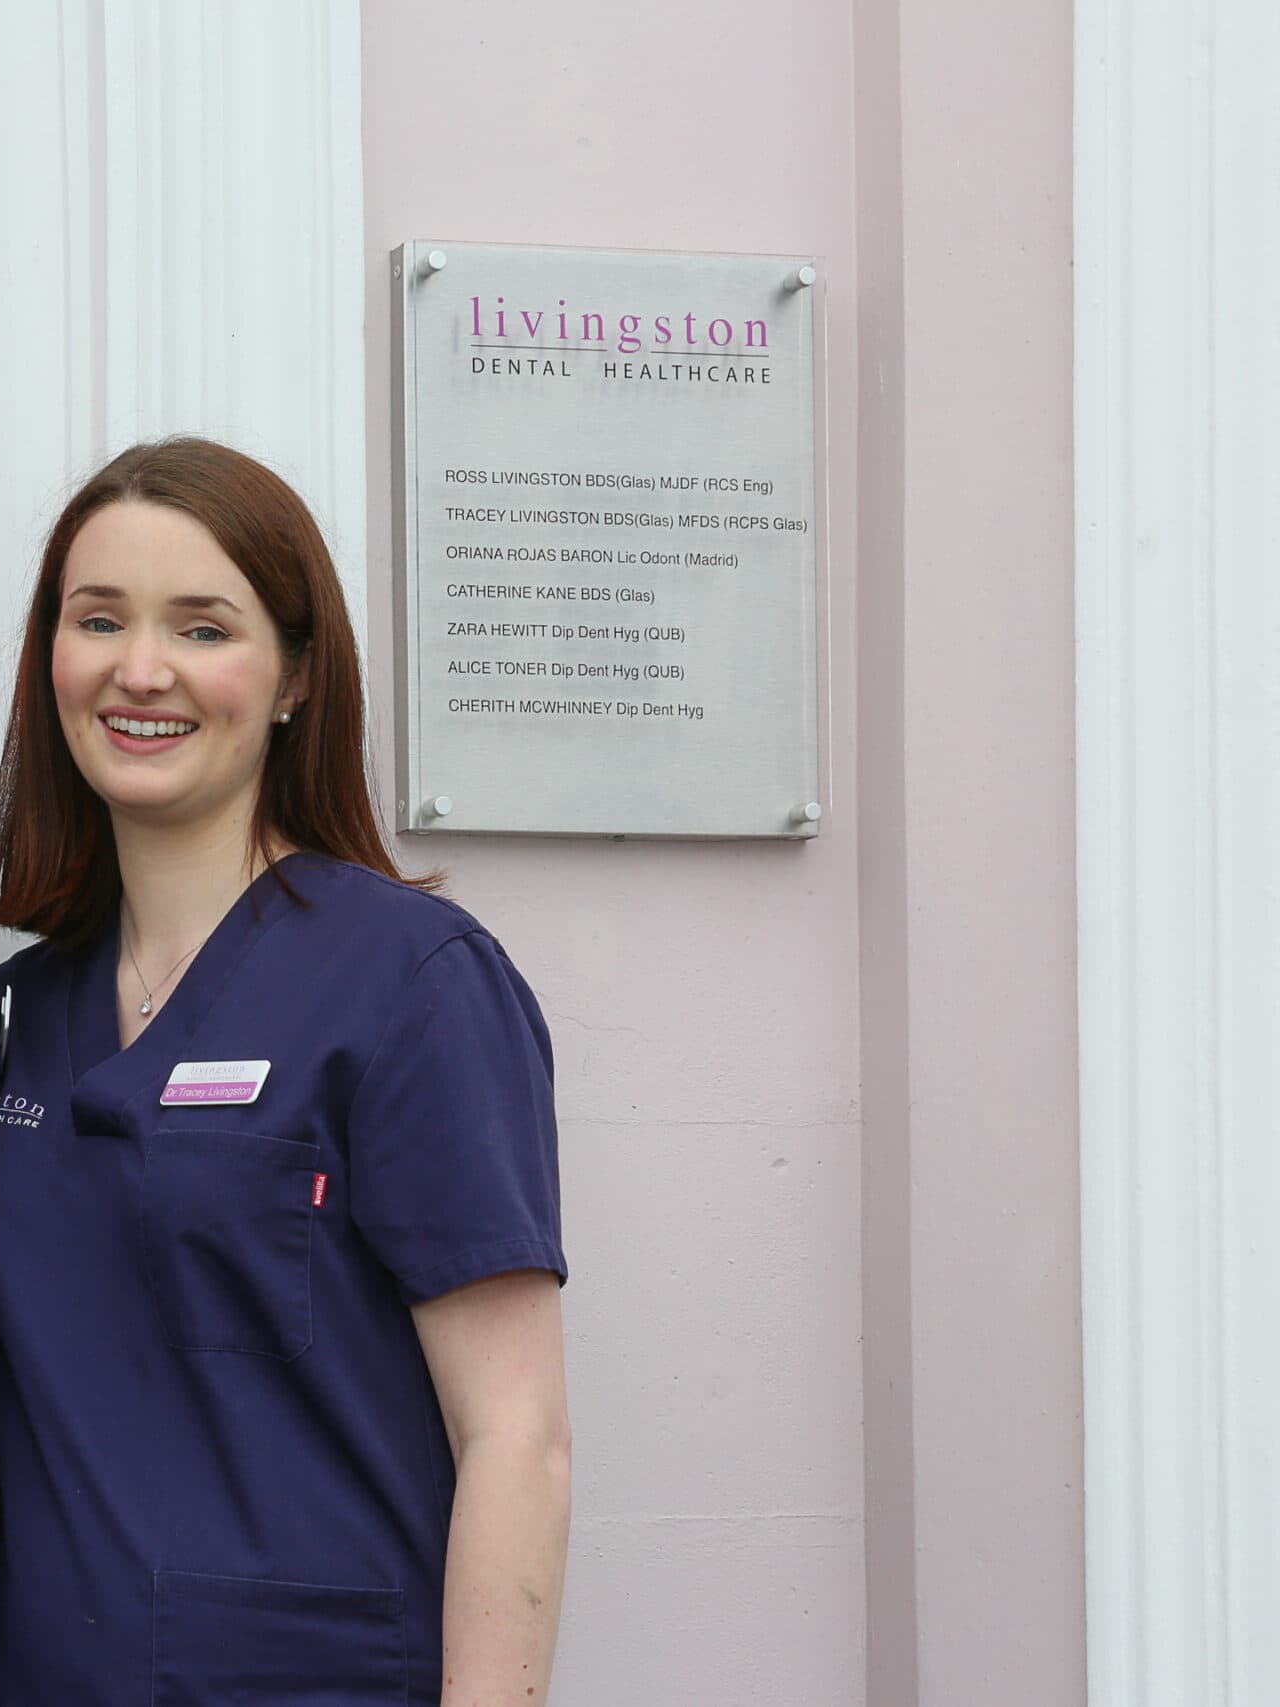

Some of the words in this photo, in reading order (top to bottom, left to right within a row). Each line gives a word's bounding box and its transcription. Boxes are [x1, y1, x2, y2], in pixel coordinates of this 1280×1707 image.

[470, 296, 768, 354] livingston
[471, 357, 571, 377] DENTAL
[604, 361, 771, 384] HEALTHCARE
[445, 469, 488, 484] ROSS
[491, 471, 582, 487] LIVINGSTON
[585, 473, 656, 492] BDS(Glas)
[660, 475, 699, 490] MJDF
[703, 477, 739, 493] (RCS
[743, 478, 774, 496] Eng)
[444, 507, 507, 523] TRACEY
[510, 509, 600, 525] LIVINGSTON
[603, 512, 674, 531] BDS(Glas)
[678, 514, 720, 529] MFDS
[723, 515, 769, 531] (RCPS
[772, 516, 808, 534] Glas)
[446, 545, 504, 561] ORIANA
[507, 547, 557, 562] ROJAS
[560, 548, 613, 564] BARON
[617, 550, 637, 564] Lic
[639, 550, 681, 565] Odont
[684, 552, 739, 570] (Madrid)
[446, 583, 532, 599] CATHERINE
[536, 586, 577, 601] KANE
[580, 587, 612, 601] BDS
[615, 588, 655, 606] (Glas)
[447, 622, 488, 636] ZARA
[490, 623, 549, 638] HEWITT
[551, 624, 575, 641] Dip
[578, 625, 610, 640] Dent
[613, 626, 640, 643] Hyg
[643, 626, 685, 644] (QUB)
[447, 660, 492, 675] ALICE
[494, 661, 547, 676] TONER
[551, 662, 574, 680] Dip
[577, 663, 609, 678] Dent
[612, 663, 640, 681] Hyg
[643, 664, 685, 681] (QUB)
[448, 698, 515, 713] CHERITH
[519, 699, 613, 715] MCWHINNEY
[616, 701, 639, 719] Dip
[642, 702, 674, 717] Dent
[677, 703, 704, 721] Hyg
[166, 1088, 178, 1097] Dr
[180, 1087, 206, 1099] Tracey
[208, 1086, 252, 1098] Livingston
